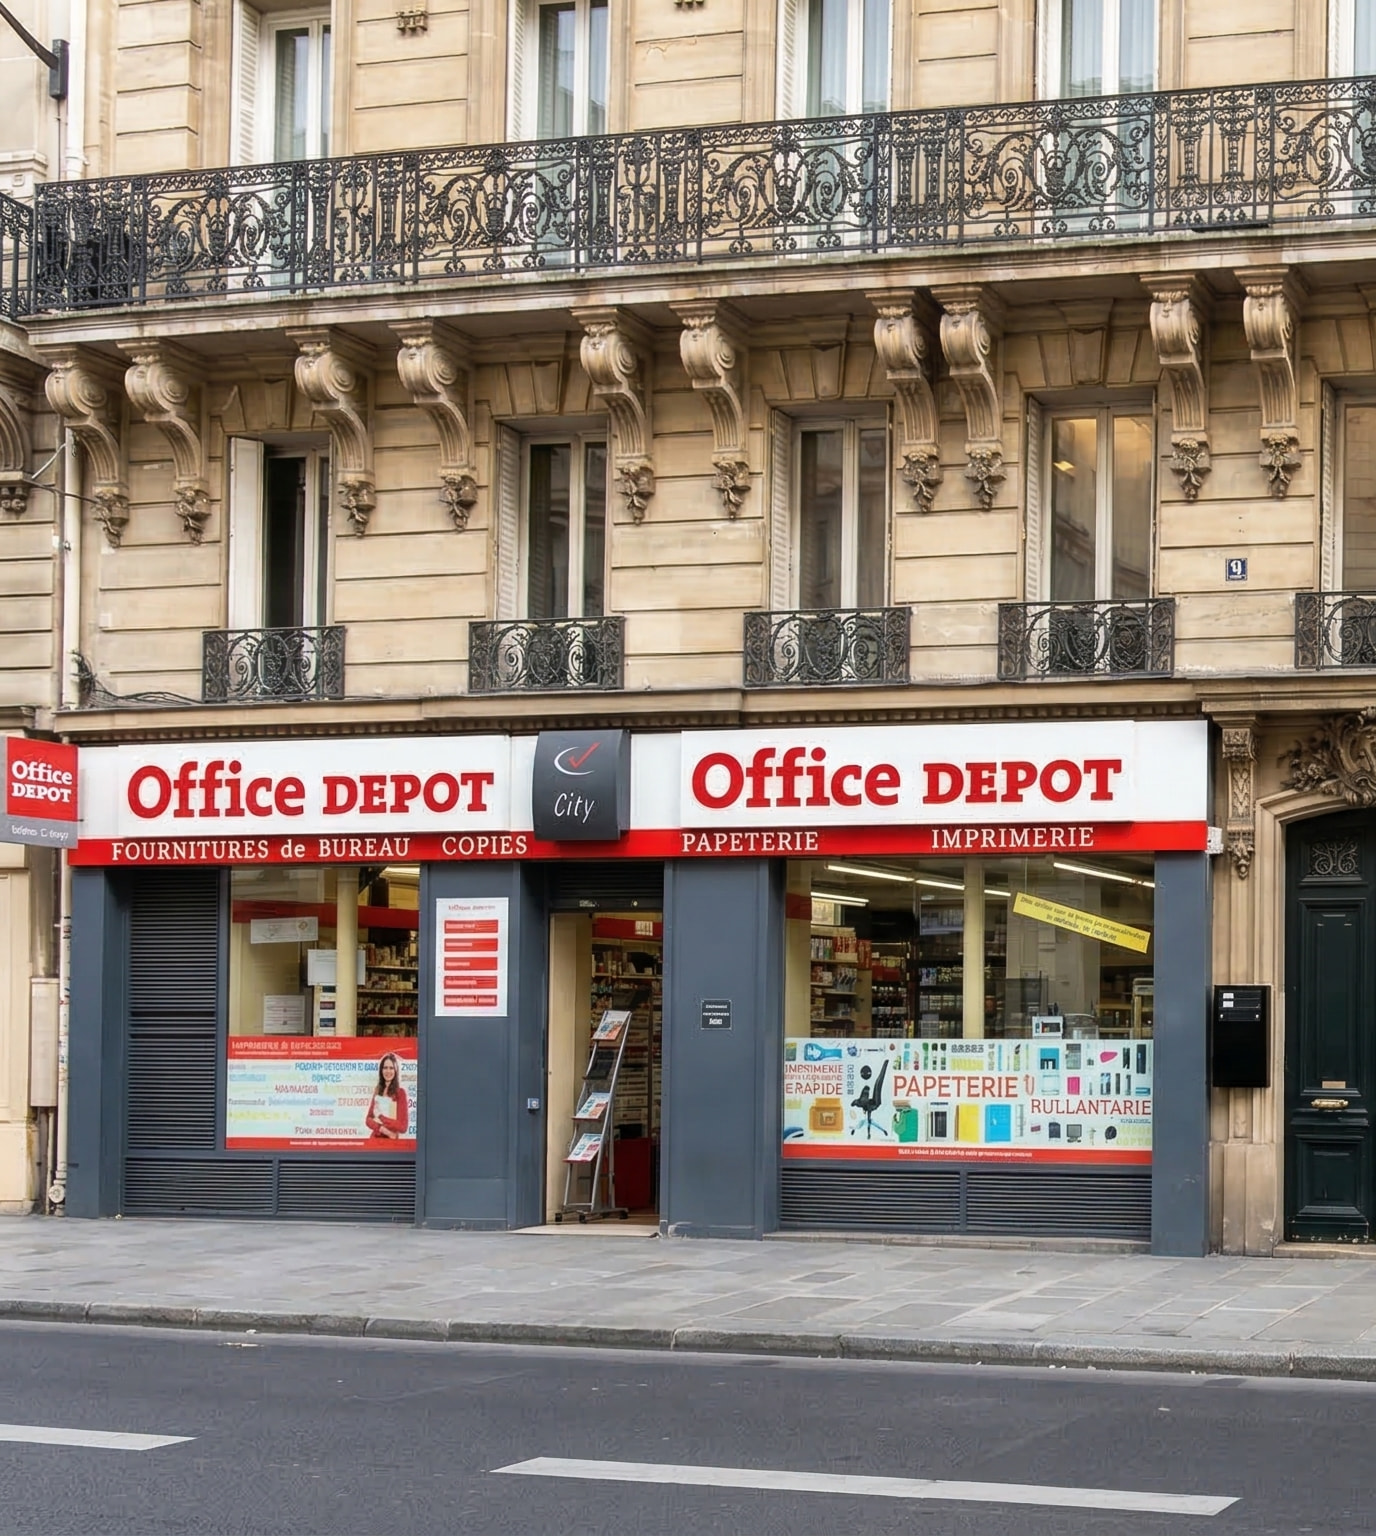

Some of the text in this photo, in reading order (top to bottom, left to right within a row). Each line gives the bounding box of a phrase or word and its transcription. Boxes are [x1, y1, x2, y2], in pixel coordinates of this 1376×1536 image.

[12, 760, 73, 785] Office
[692, 747, 1122, 809] Office DEPOT
[11, 782, 72, 803] DEPOT
[128, 761, 494, 818] Office DEPOT
[553, 791, 595, 824] City
[111, 836, 527, 861] FOURNITURES de BUREAU COPIES
[682, 827, 1094, 852] PAPETERIE IMPRIMERIE
[893, 1075, 1018, 1098] PAPETERIE
[1031, 1099, 1152, 1115] RULLANTARIE
